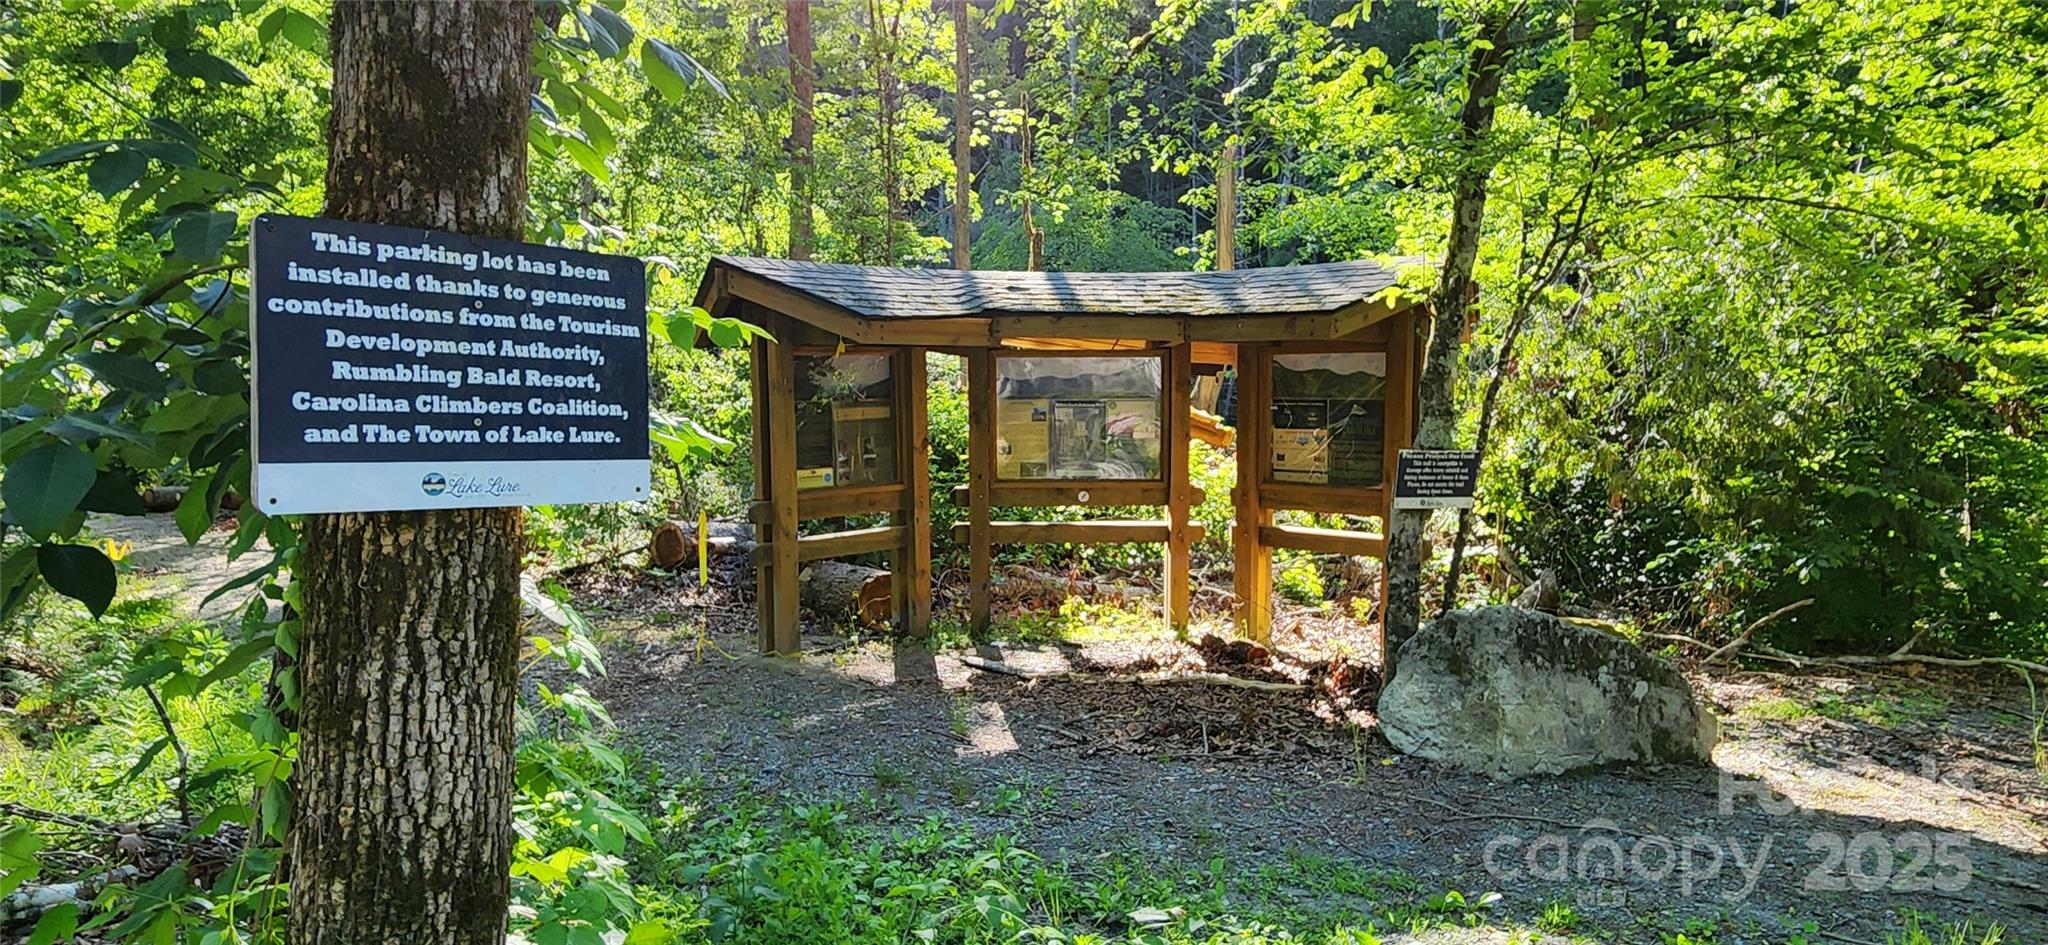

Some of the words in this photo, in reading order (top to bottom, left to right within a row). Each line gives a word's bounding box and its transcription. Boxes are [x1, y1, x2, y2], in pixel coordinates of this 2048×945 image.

[312, 231, 371, 256] This
[376, 243, 478, 271] parking
[482, 251, 513, 271] lot
[517, 256, 556, 277] has
[560, 260, 610, 282] been
[288, 262, 411, 291] installed
[415, 275, 499, 298] thanks
[503, 283, 526, 301] to
[531, 289, 626, 310] generous
[267, 298, 454, 325] contributions
[459, 308, 516, 330] from
[520, 313, 555, 332] the
[559, 316, 641, 338] Tourism
[325, 329, 495, 357] Development
[500, 339, 605, 366] Authority,
[332, 361, 462, 389] Rumbling
[467, 366, 521, 386] Bald
[525, 371, 601, 392] Resort,
[292, 392, 410, 413] Carolina
[415, 395, 523, 415] Climbers
[527, 399, 628, 419] Coalition,
[304, 424, 358, 443] and
[363, 425, 411, 443] The
[415, 425, 480, 443] Town
[485, 426, 508, 443] of
[512, 426, 564, 443] Lake
[568, 426, 621, 443] Lure.
[446, 477, 483, 498] Lake
[485, 476, 520, 497] Lure
